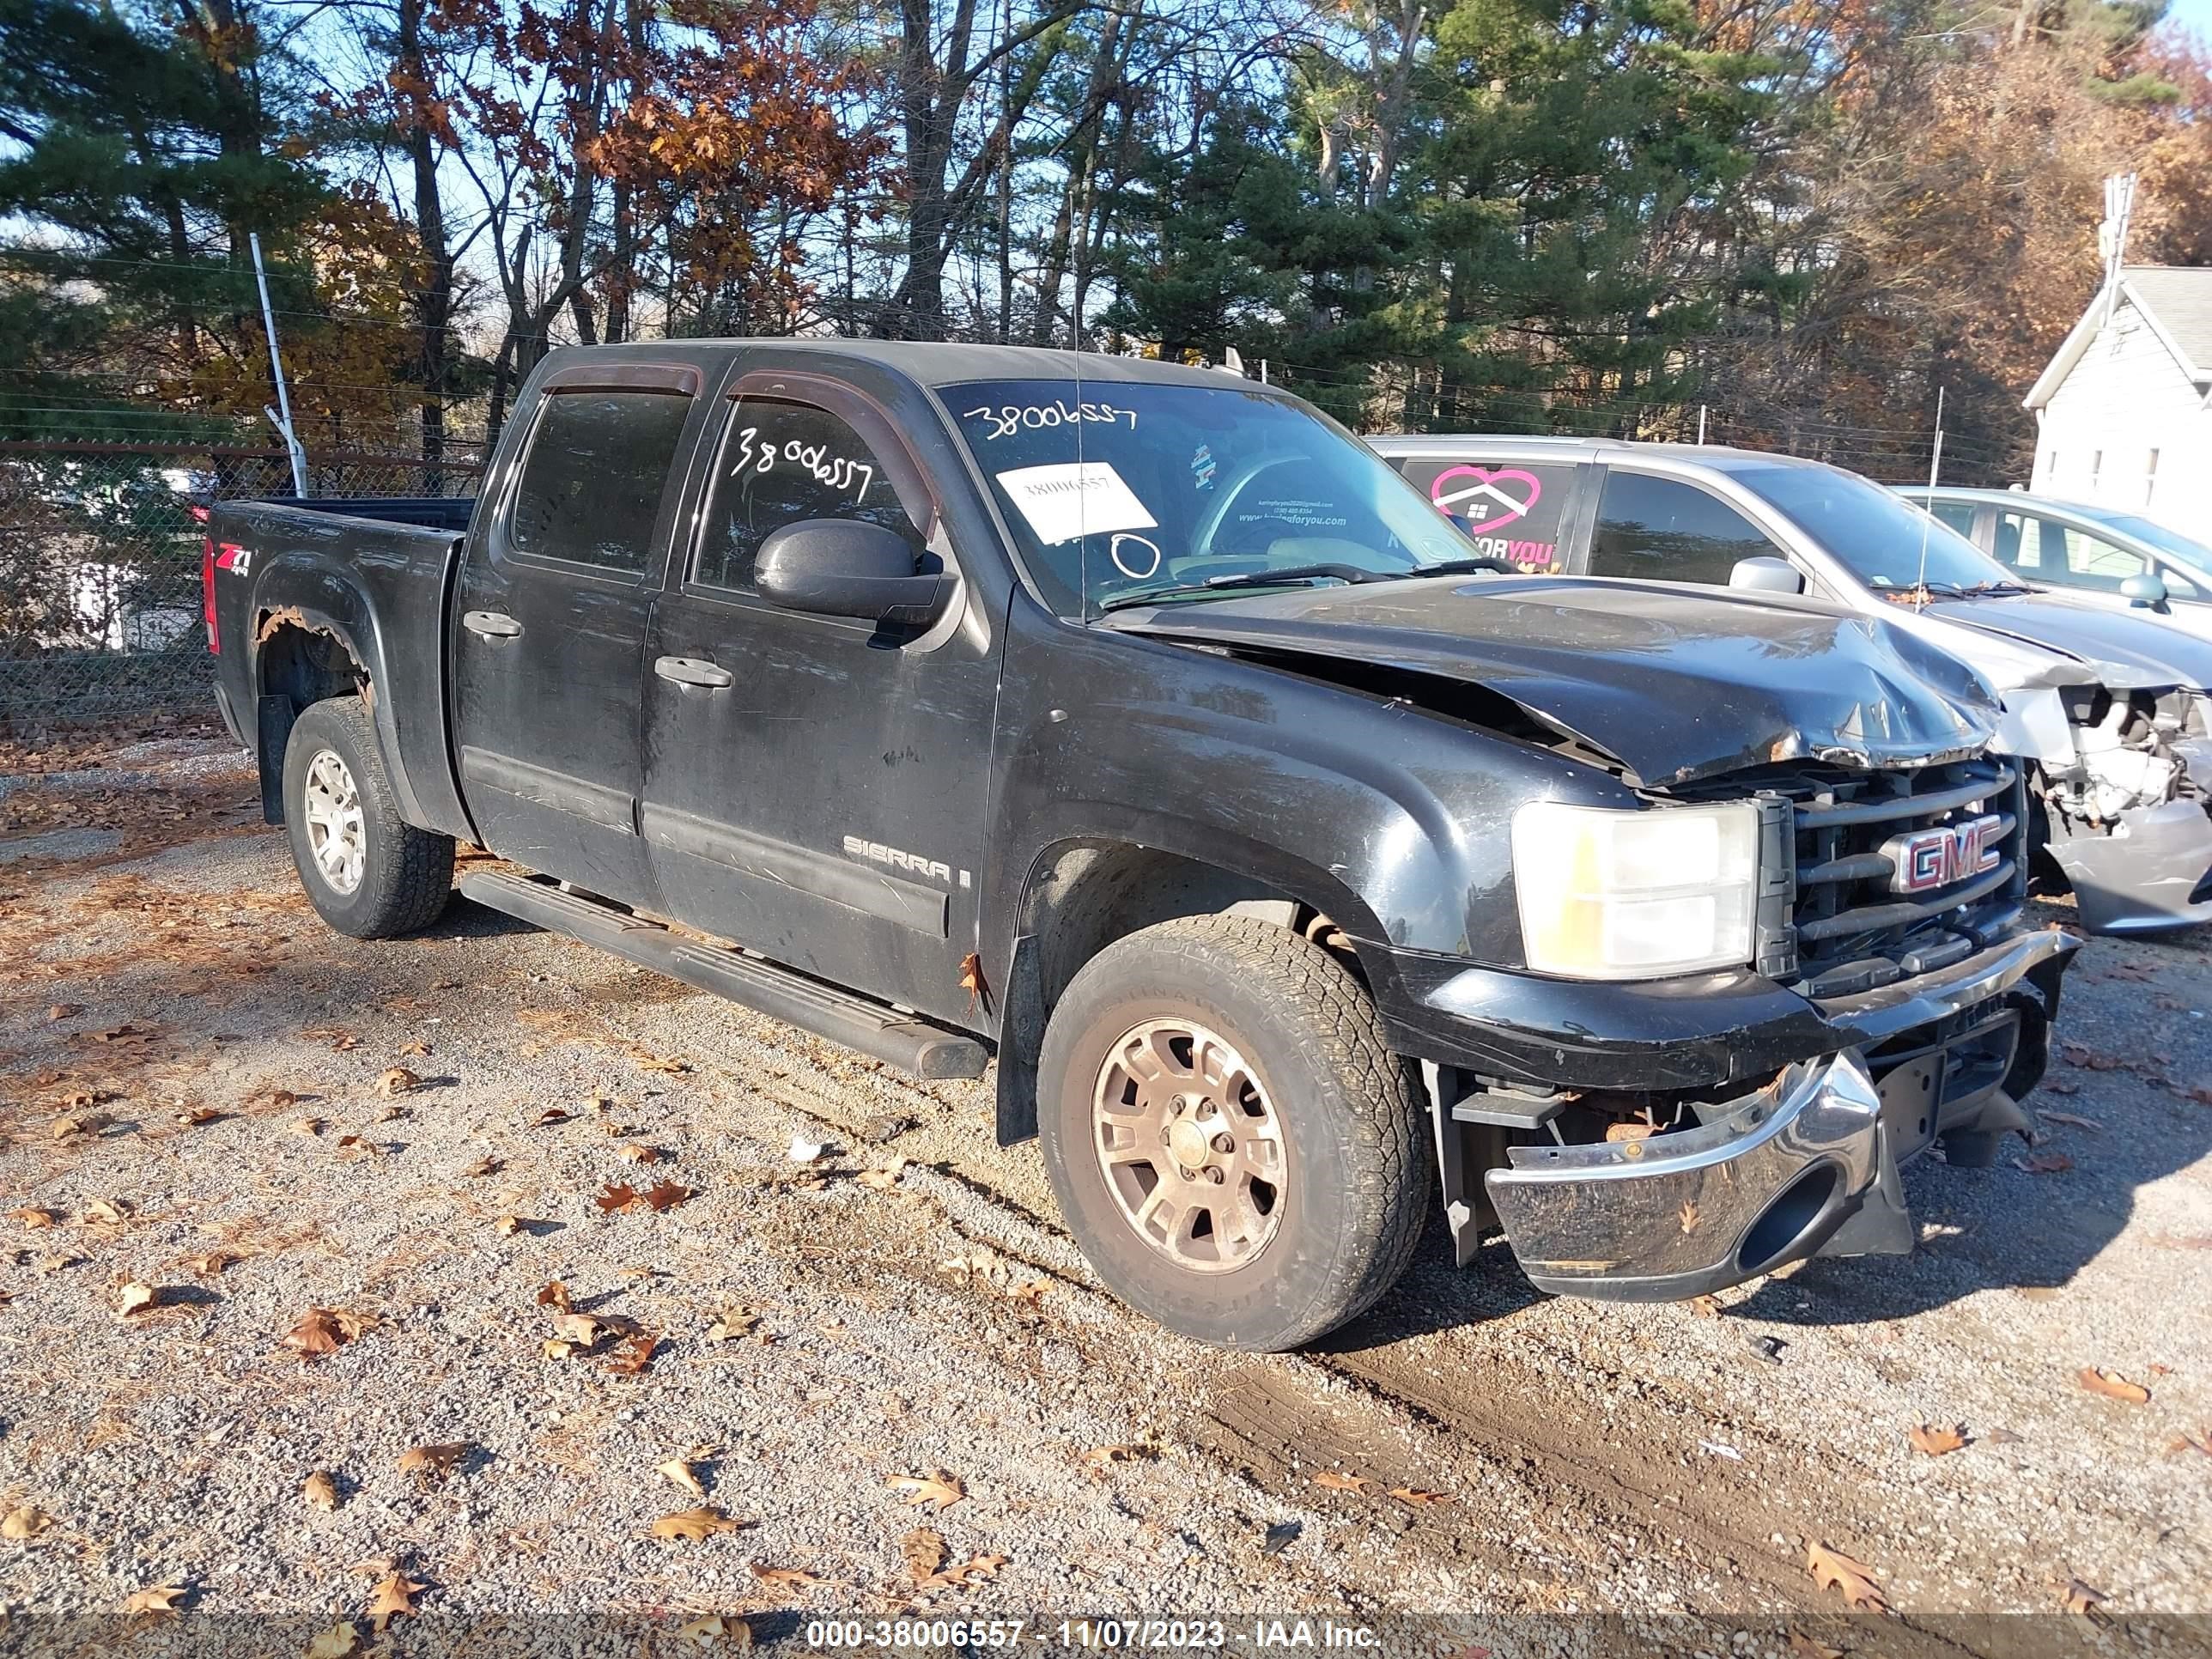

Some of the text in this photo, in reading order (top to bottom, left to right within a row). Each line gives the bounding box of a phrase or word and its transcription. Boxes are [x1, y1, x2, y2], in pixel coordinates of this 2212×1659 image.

[963, 400, 1138, 441] 38006557
[730, 427, 873, 505] 38006557
[1024, 477, 1110, 496] 38006557
[216, 543, 252, 568] Z71
[1475, 537, 1553, 564] ORYOU
[843, 836, 951, 884] SIERRA
[1899, 814, 2001, 894] GMC
